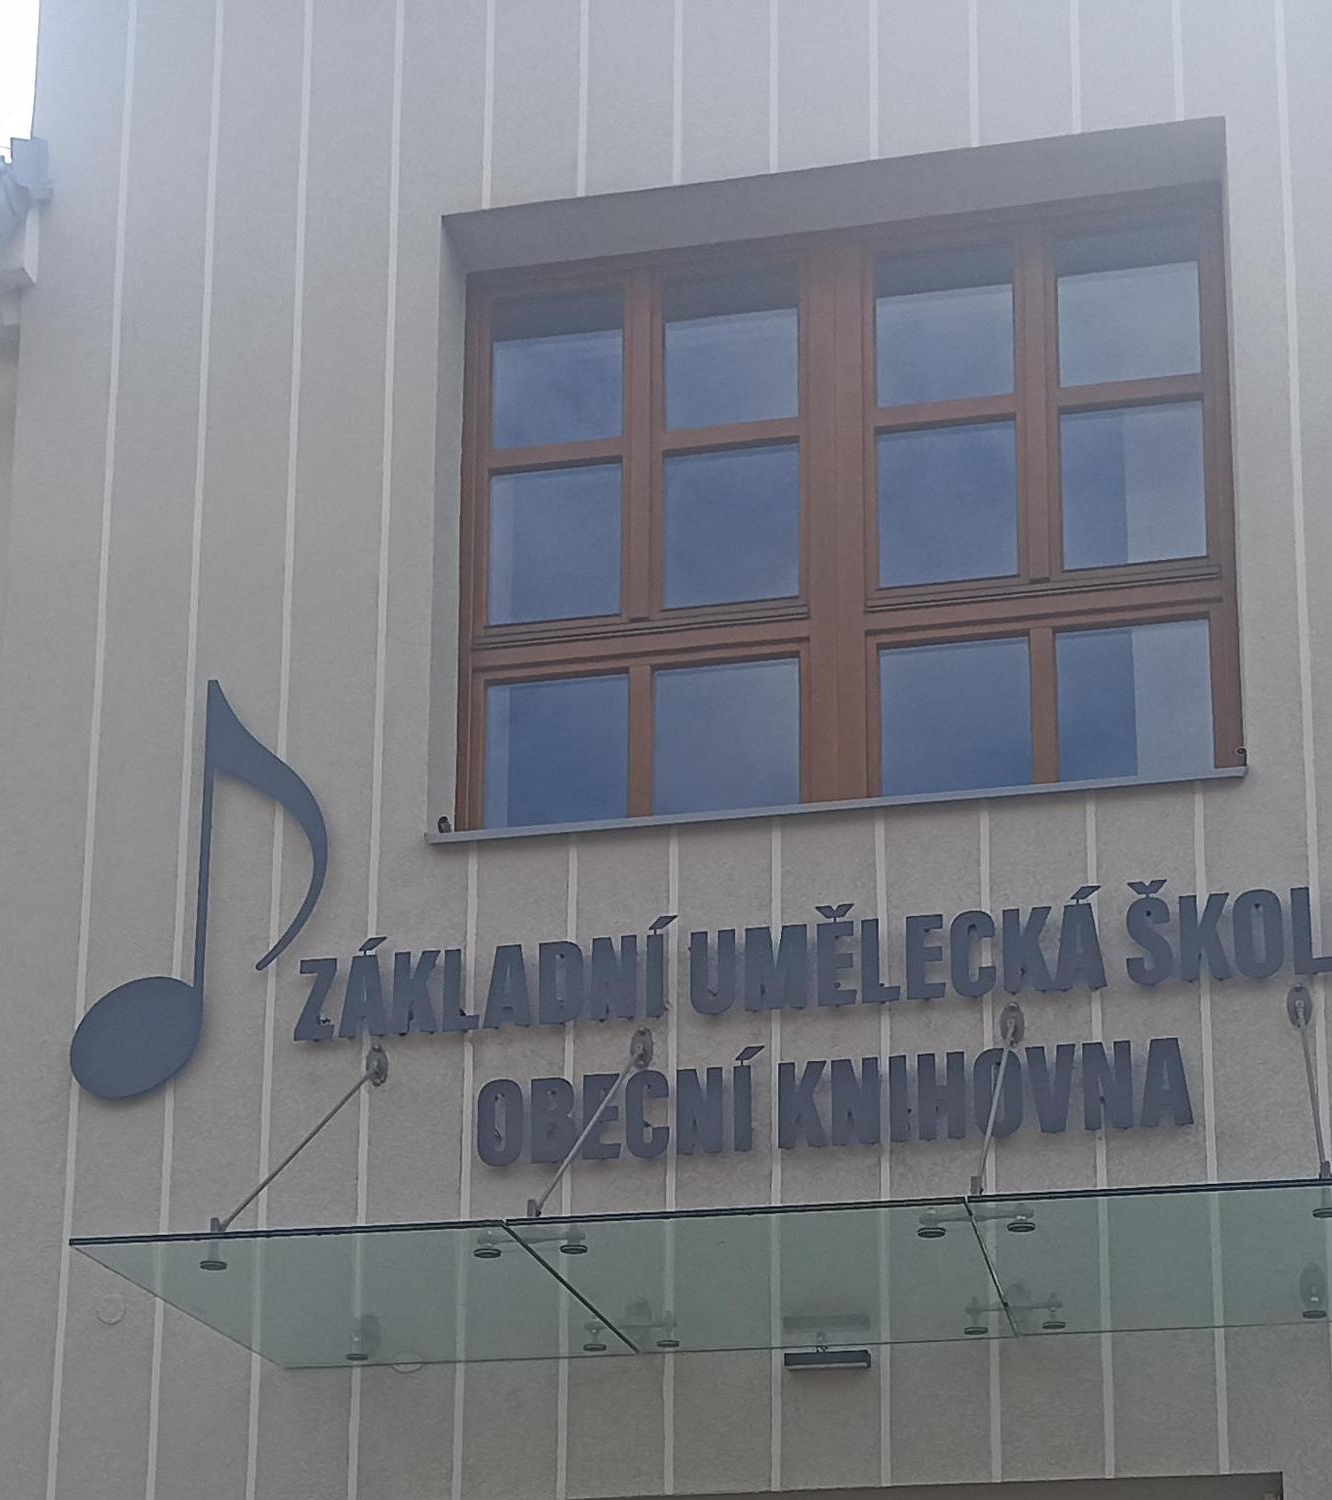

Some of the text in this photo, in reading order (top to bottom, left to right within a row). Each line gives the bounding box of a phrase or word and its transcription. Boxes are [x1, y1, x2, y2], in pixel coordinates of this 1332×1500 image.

[294, 915, 677, 1041] ZÁKLADNÍ
[689, 885, 1107, 1015] UMĚLECKÁ
[477, 1037, 1195, 1167] OBECNÍ KNIHOVNA
